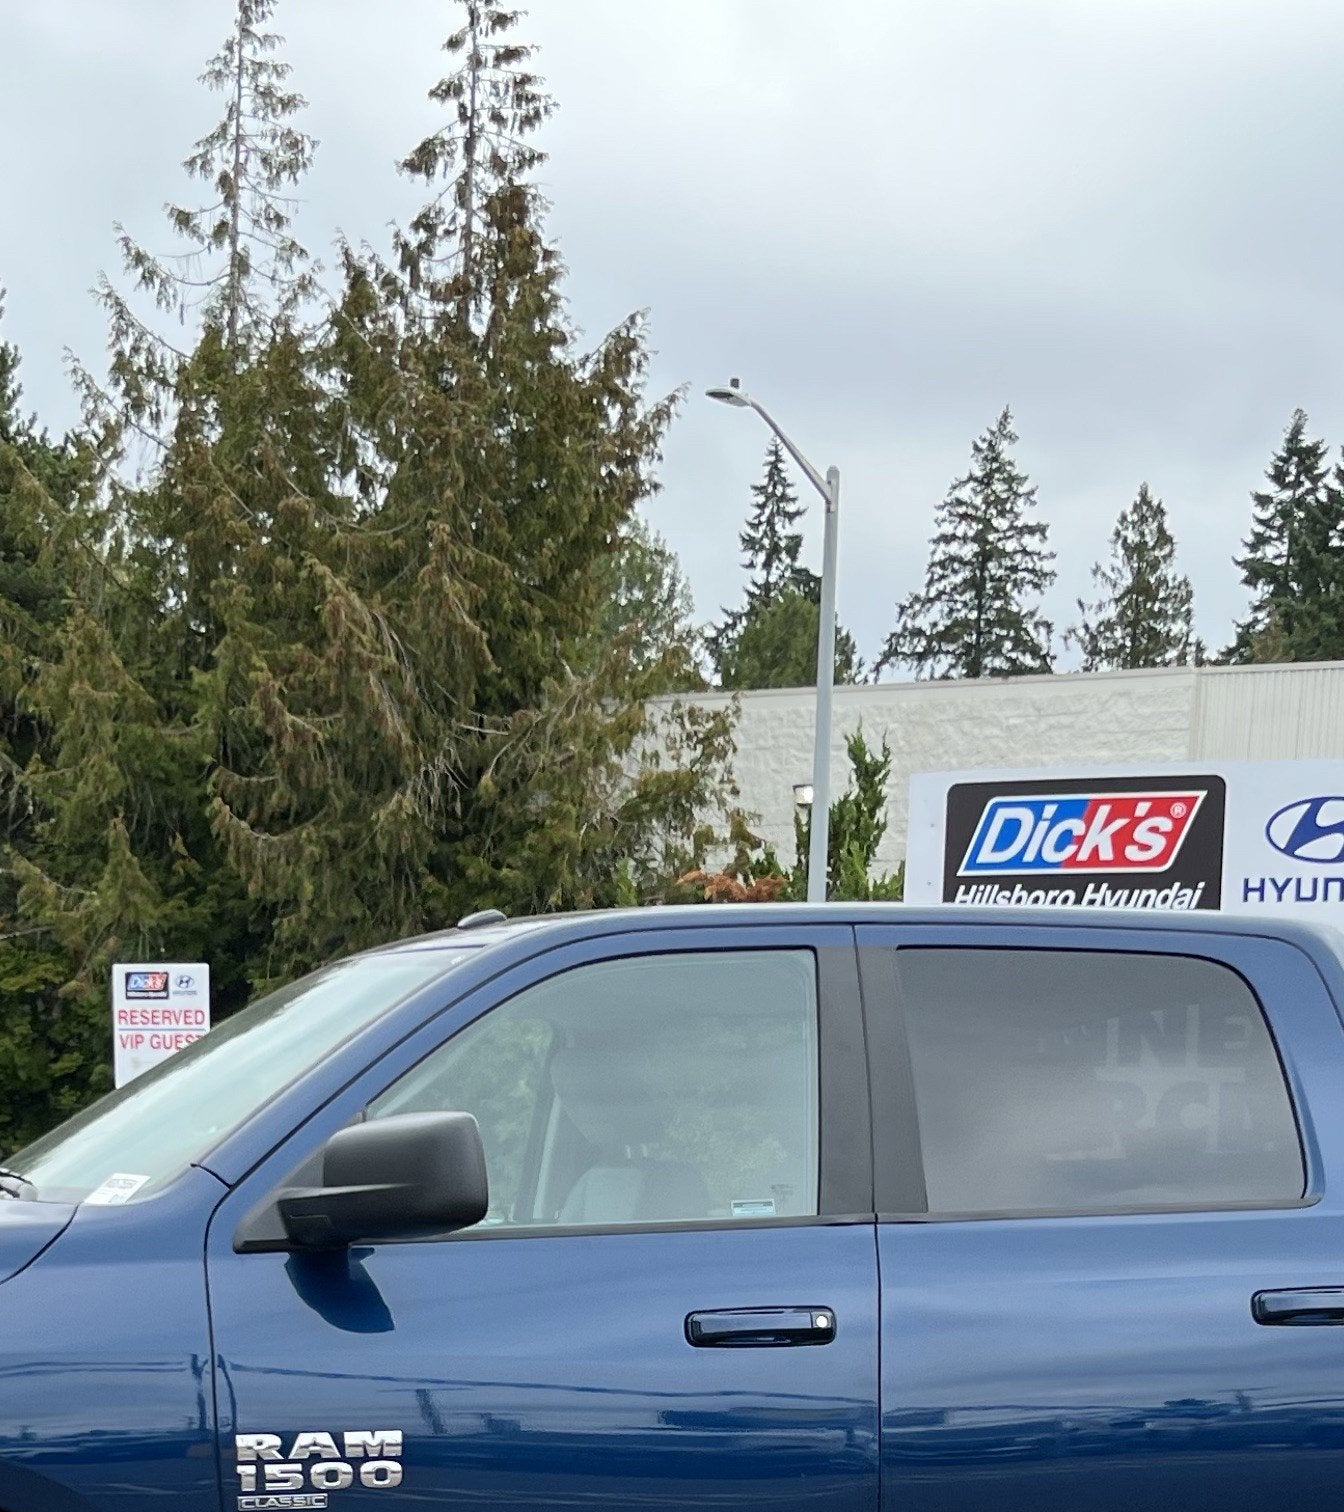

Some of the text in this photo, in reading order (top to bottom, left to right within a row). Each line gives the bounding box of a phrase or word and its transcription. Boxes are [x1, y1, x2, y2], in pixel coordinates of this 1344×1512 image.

[975, 802, 1173, 864] Dick's
[118, 1009, 205, 1025] RESERVED
[119, 1034, 200, 1052] VIP GUES
[235, 1430, 403, 1462] RAM
[236, 1460, 403, 1492] 1500
[240, 1495, 326, 1510] CLASSIC
